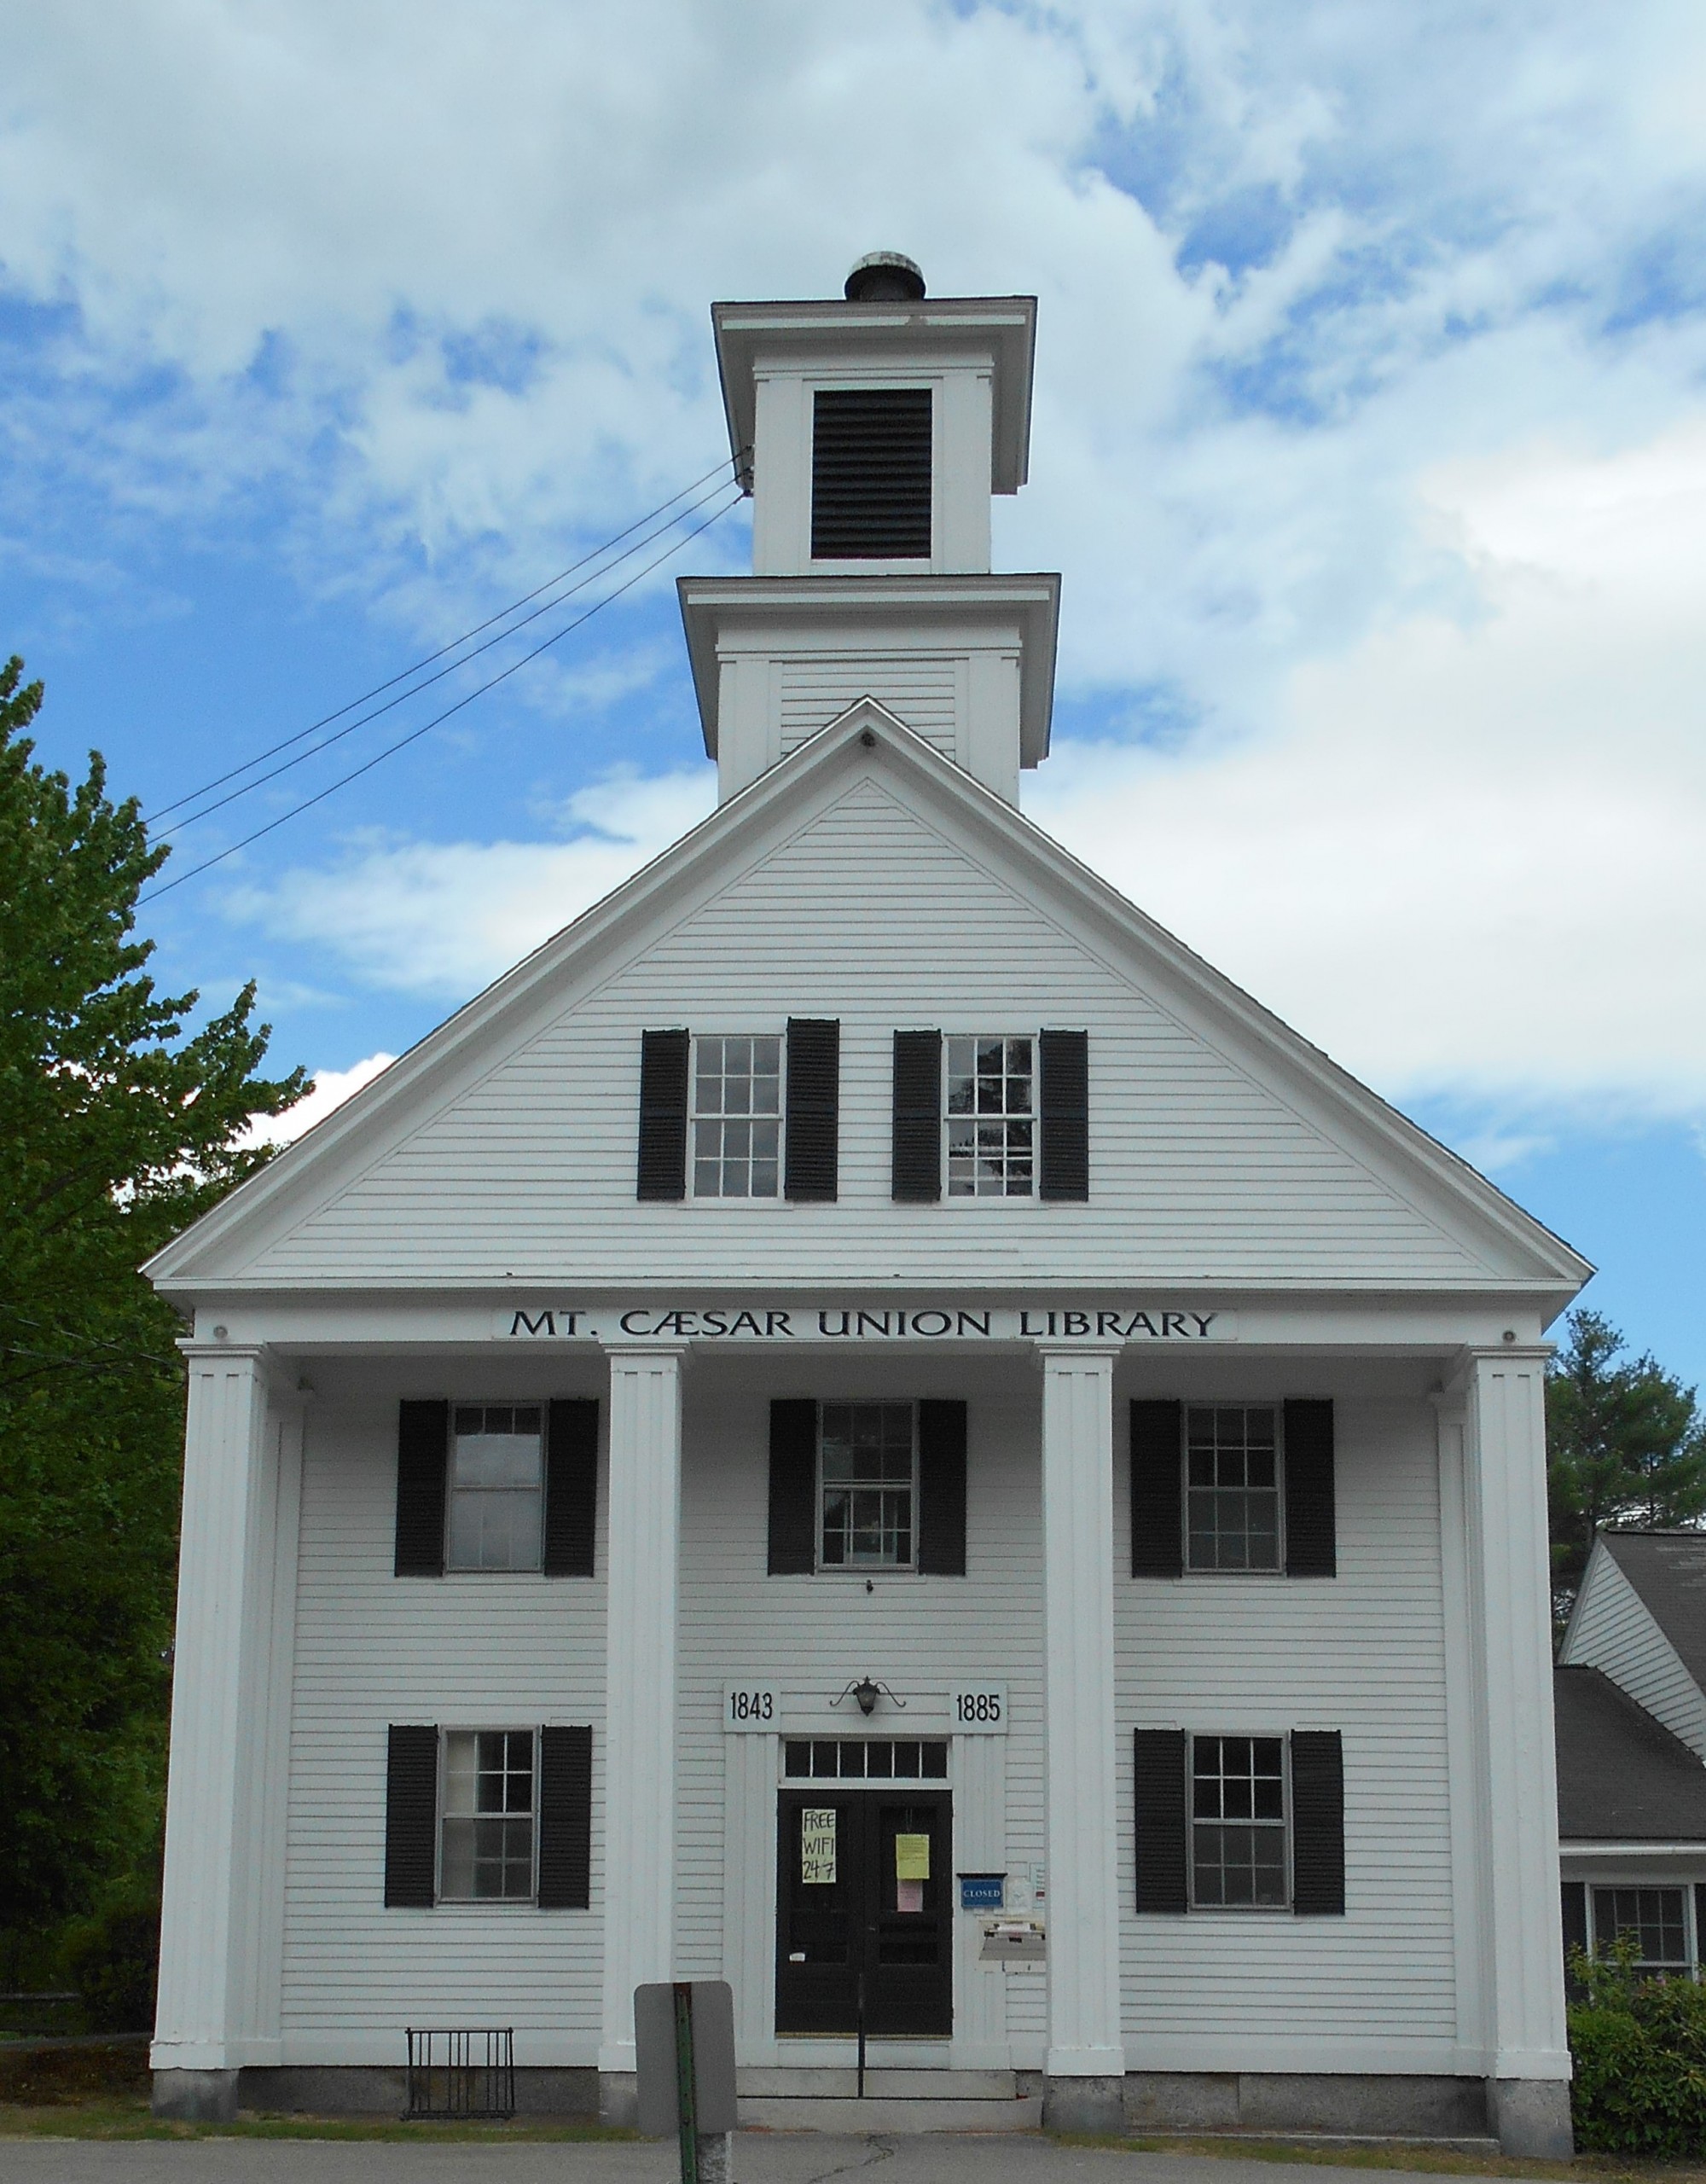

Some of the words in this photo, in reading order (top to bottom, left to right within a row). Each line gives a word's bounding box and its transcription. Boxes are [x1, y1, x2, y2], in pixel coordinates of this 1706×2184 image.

[509, 1310, 599, 1337] MT.
[619, 1310, 795, 1337] CÆSAR
[817, 1310, 991, 1337] UNION
[1018, 1310, 1221, 1338] LIBRARY
[730, 1692, 774, 1720] 1843
[956, 1693, 1001, 1722] 1885
[804, 1810, 835, 1832] FREE
[803, 1837, 834, 1856] WIFI
[803, 1860, 834, 1881] 24/7
[963, 1890, 1001, 1898] CLOSED
